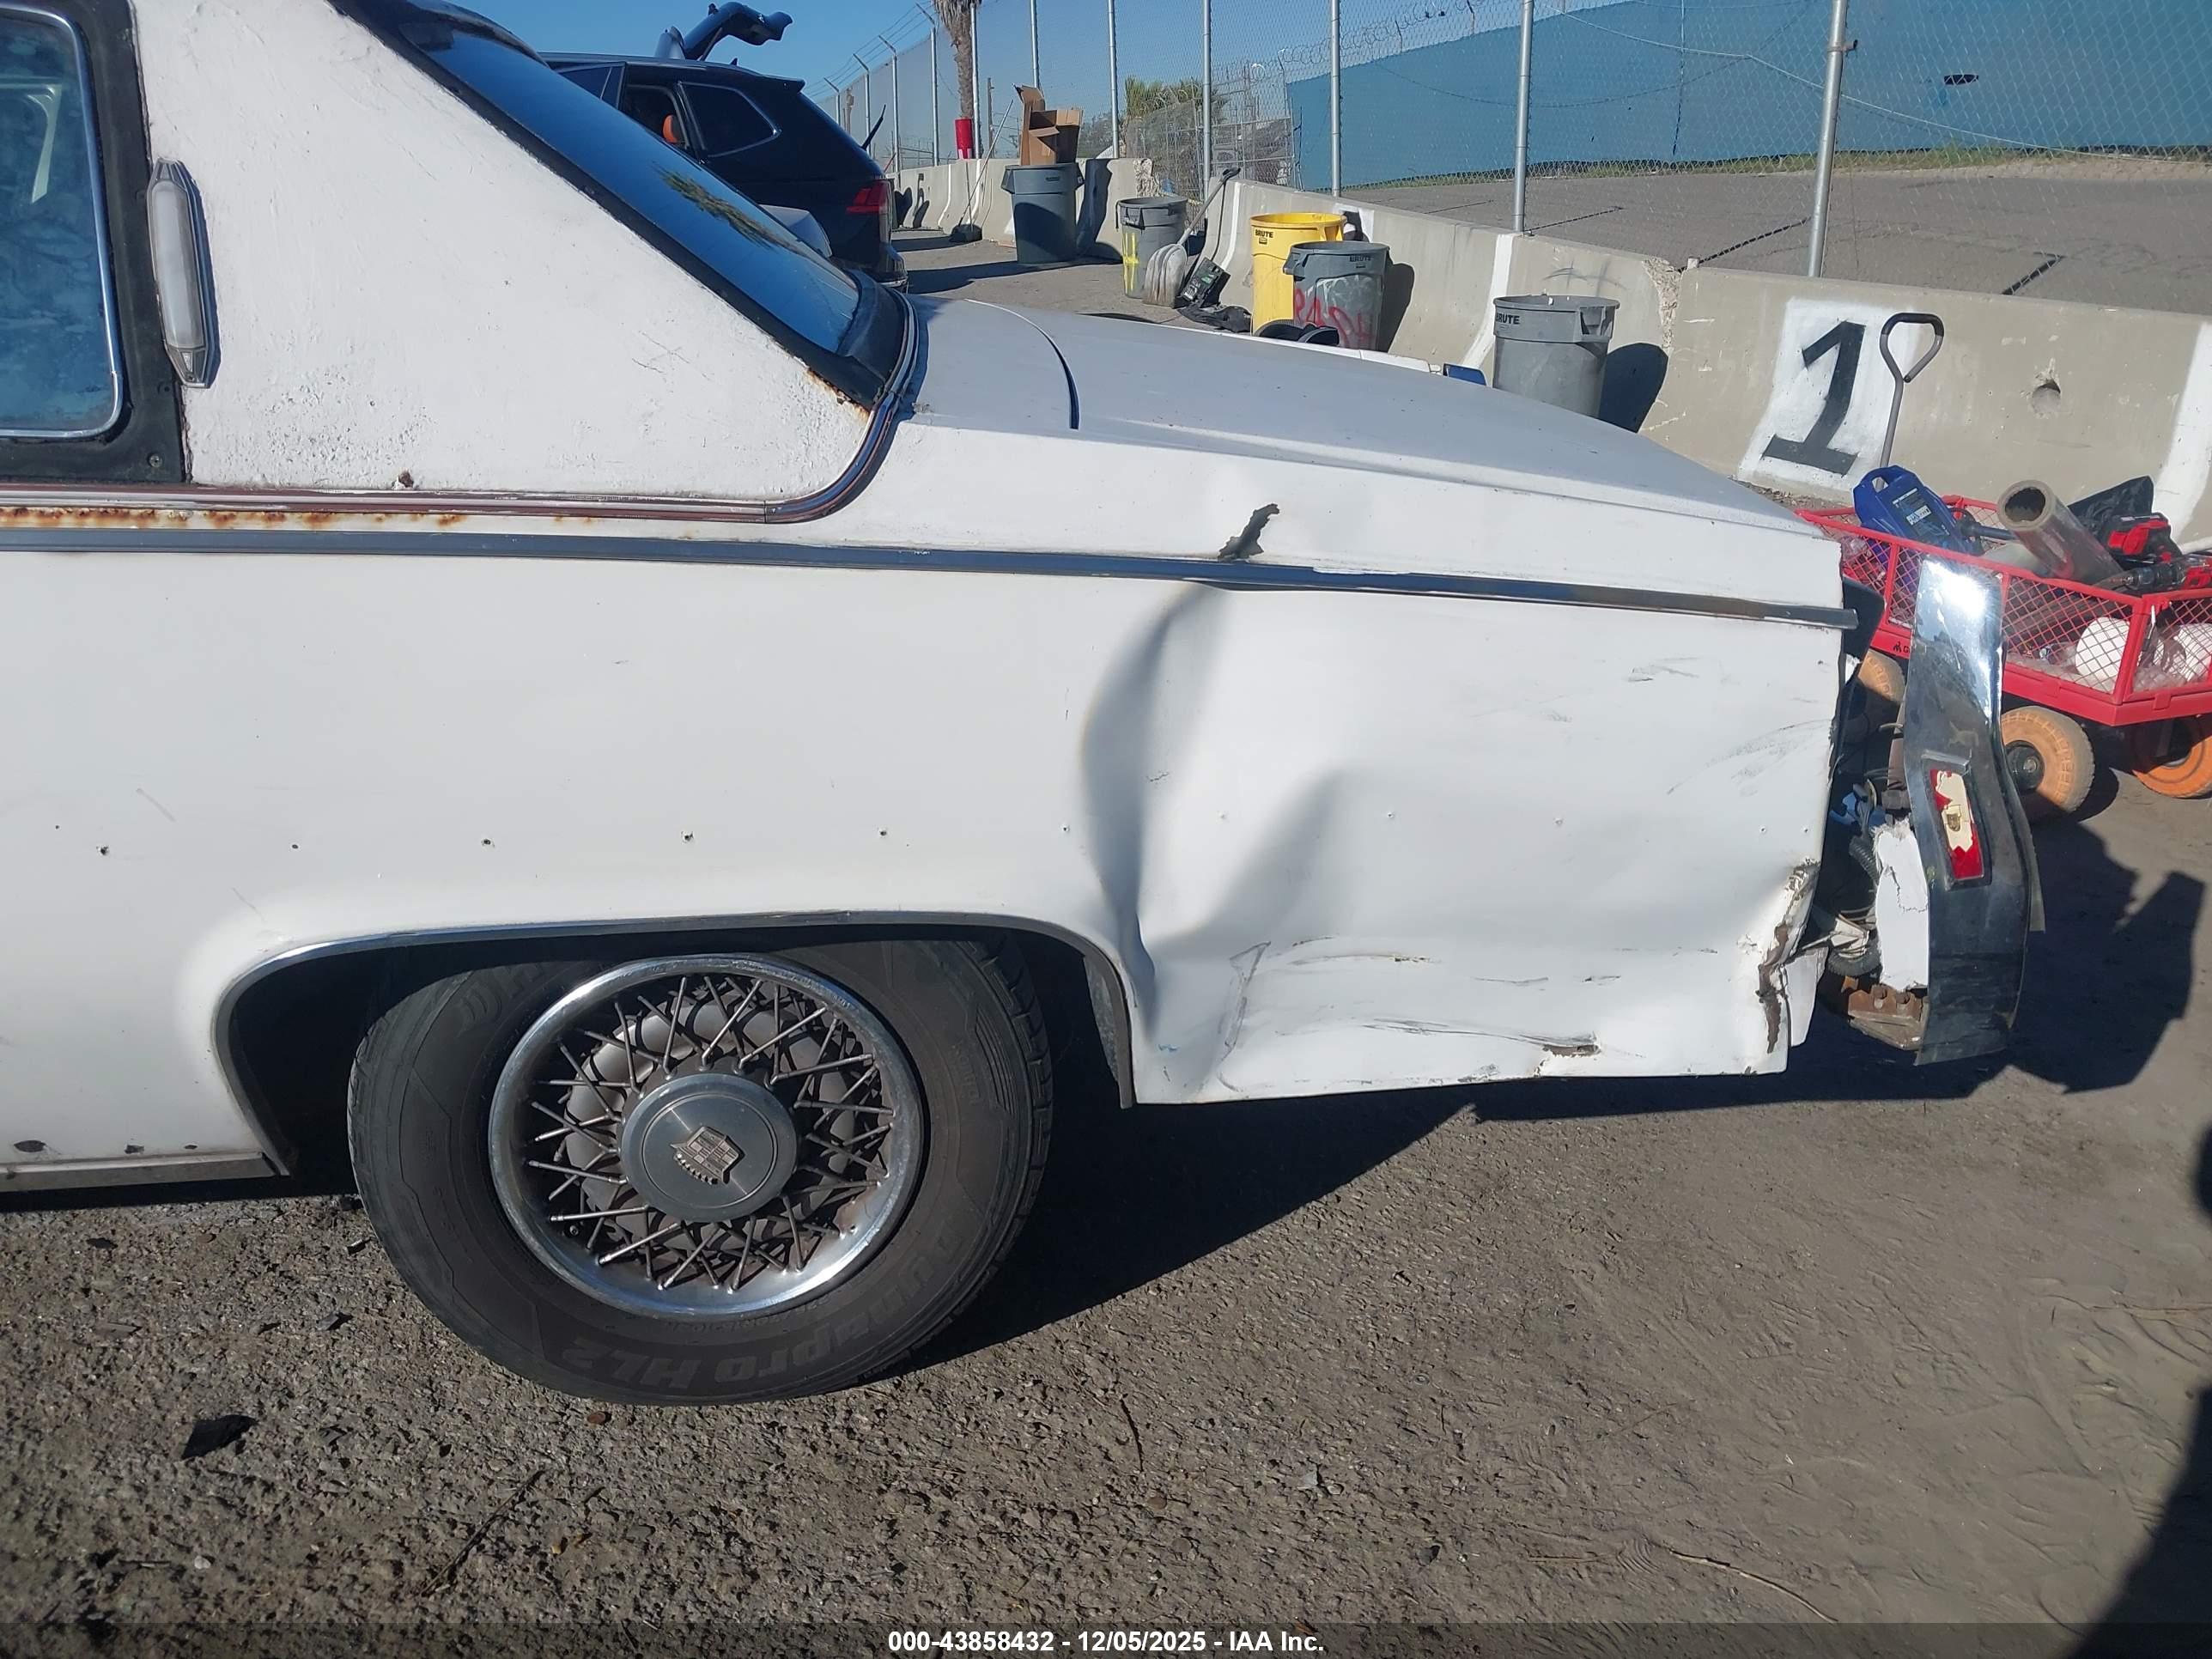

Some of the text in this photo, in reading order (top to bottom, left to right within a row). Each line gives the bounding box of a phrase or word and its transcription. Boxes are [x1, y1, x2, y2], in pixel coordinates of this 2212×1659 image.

[1255, 228, 1273, 238] BRUTE
[1495, 313, 1520, 325] BRUTE
[1761, 320, 1866, 478] 1
